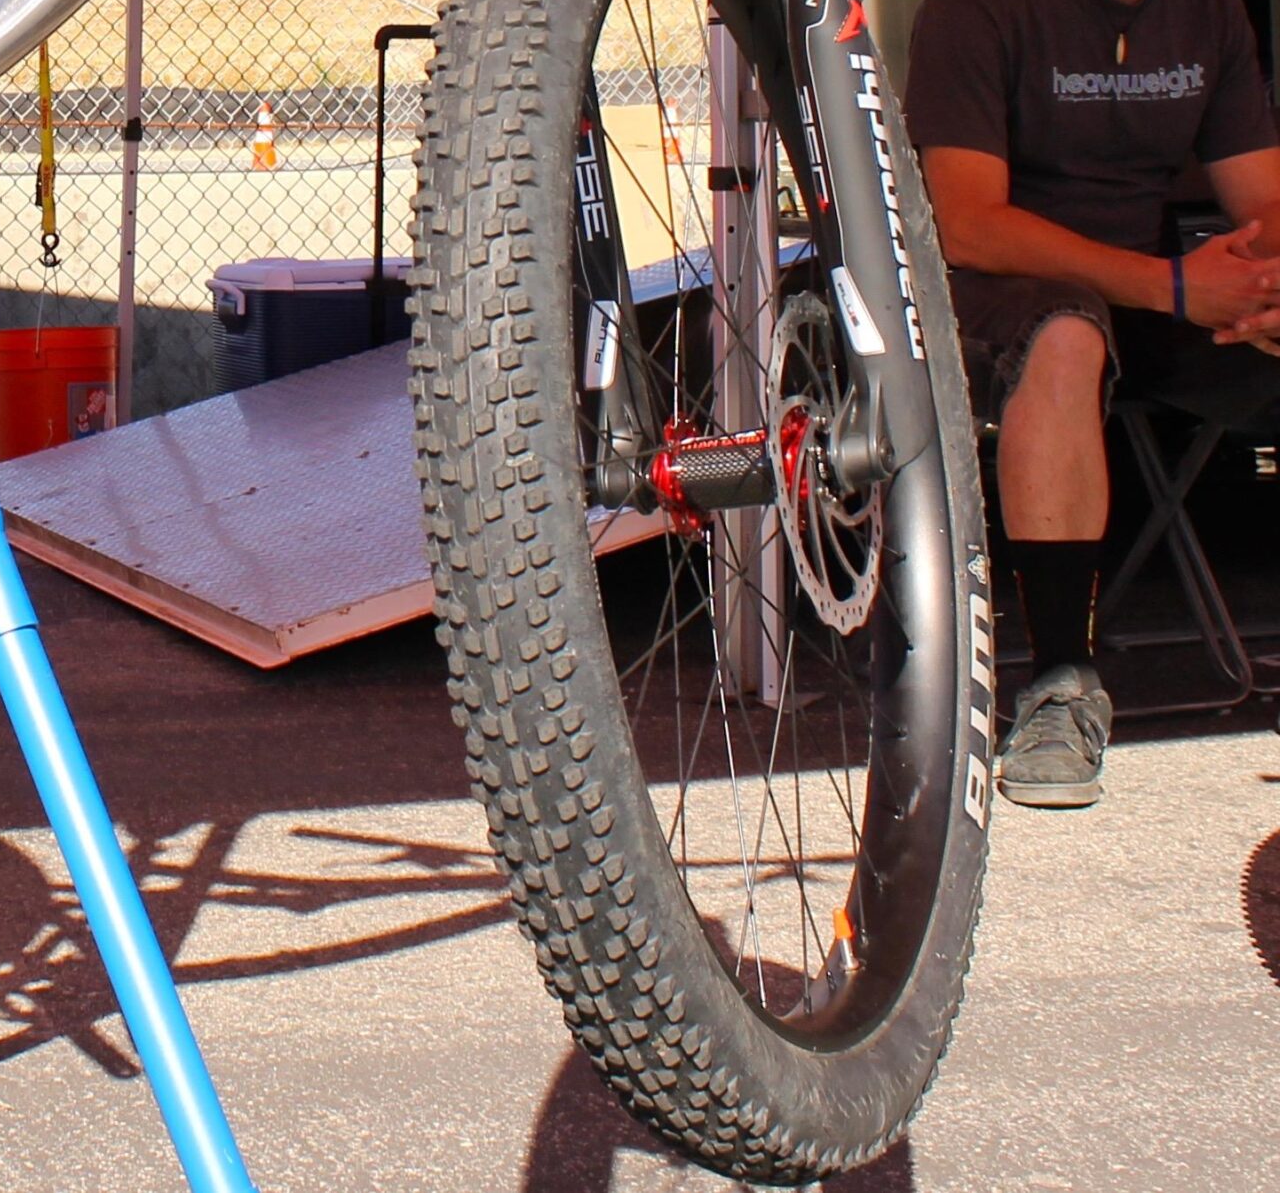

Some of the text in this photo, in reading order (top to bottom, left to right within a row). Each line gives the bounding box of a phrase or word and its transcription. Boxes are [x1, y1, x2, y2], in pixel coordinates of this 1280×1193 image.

[1053, 63, 1205, 101] heavyweight
[849, 52, 926, 361] marzocchi
[964, 592, 991, 830] WTB
